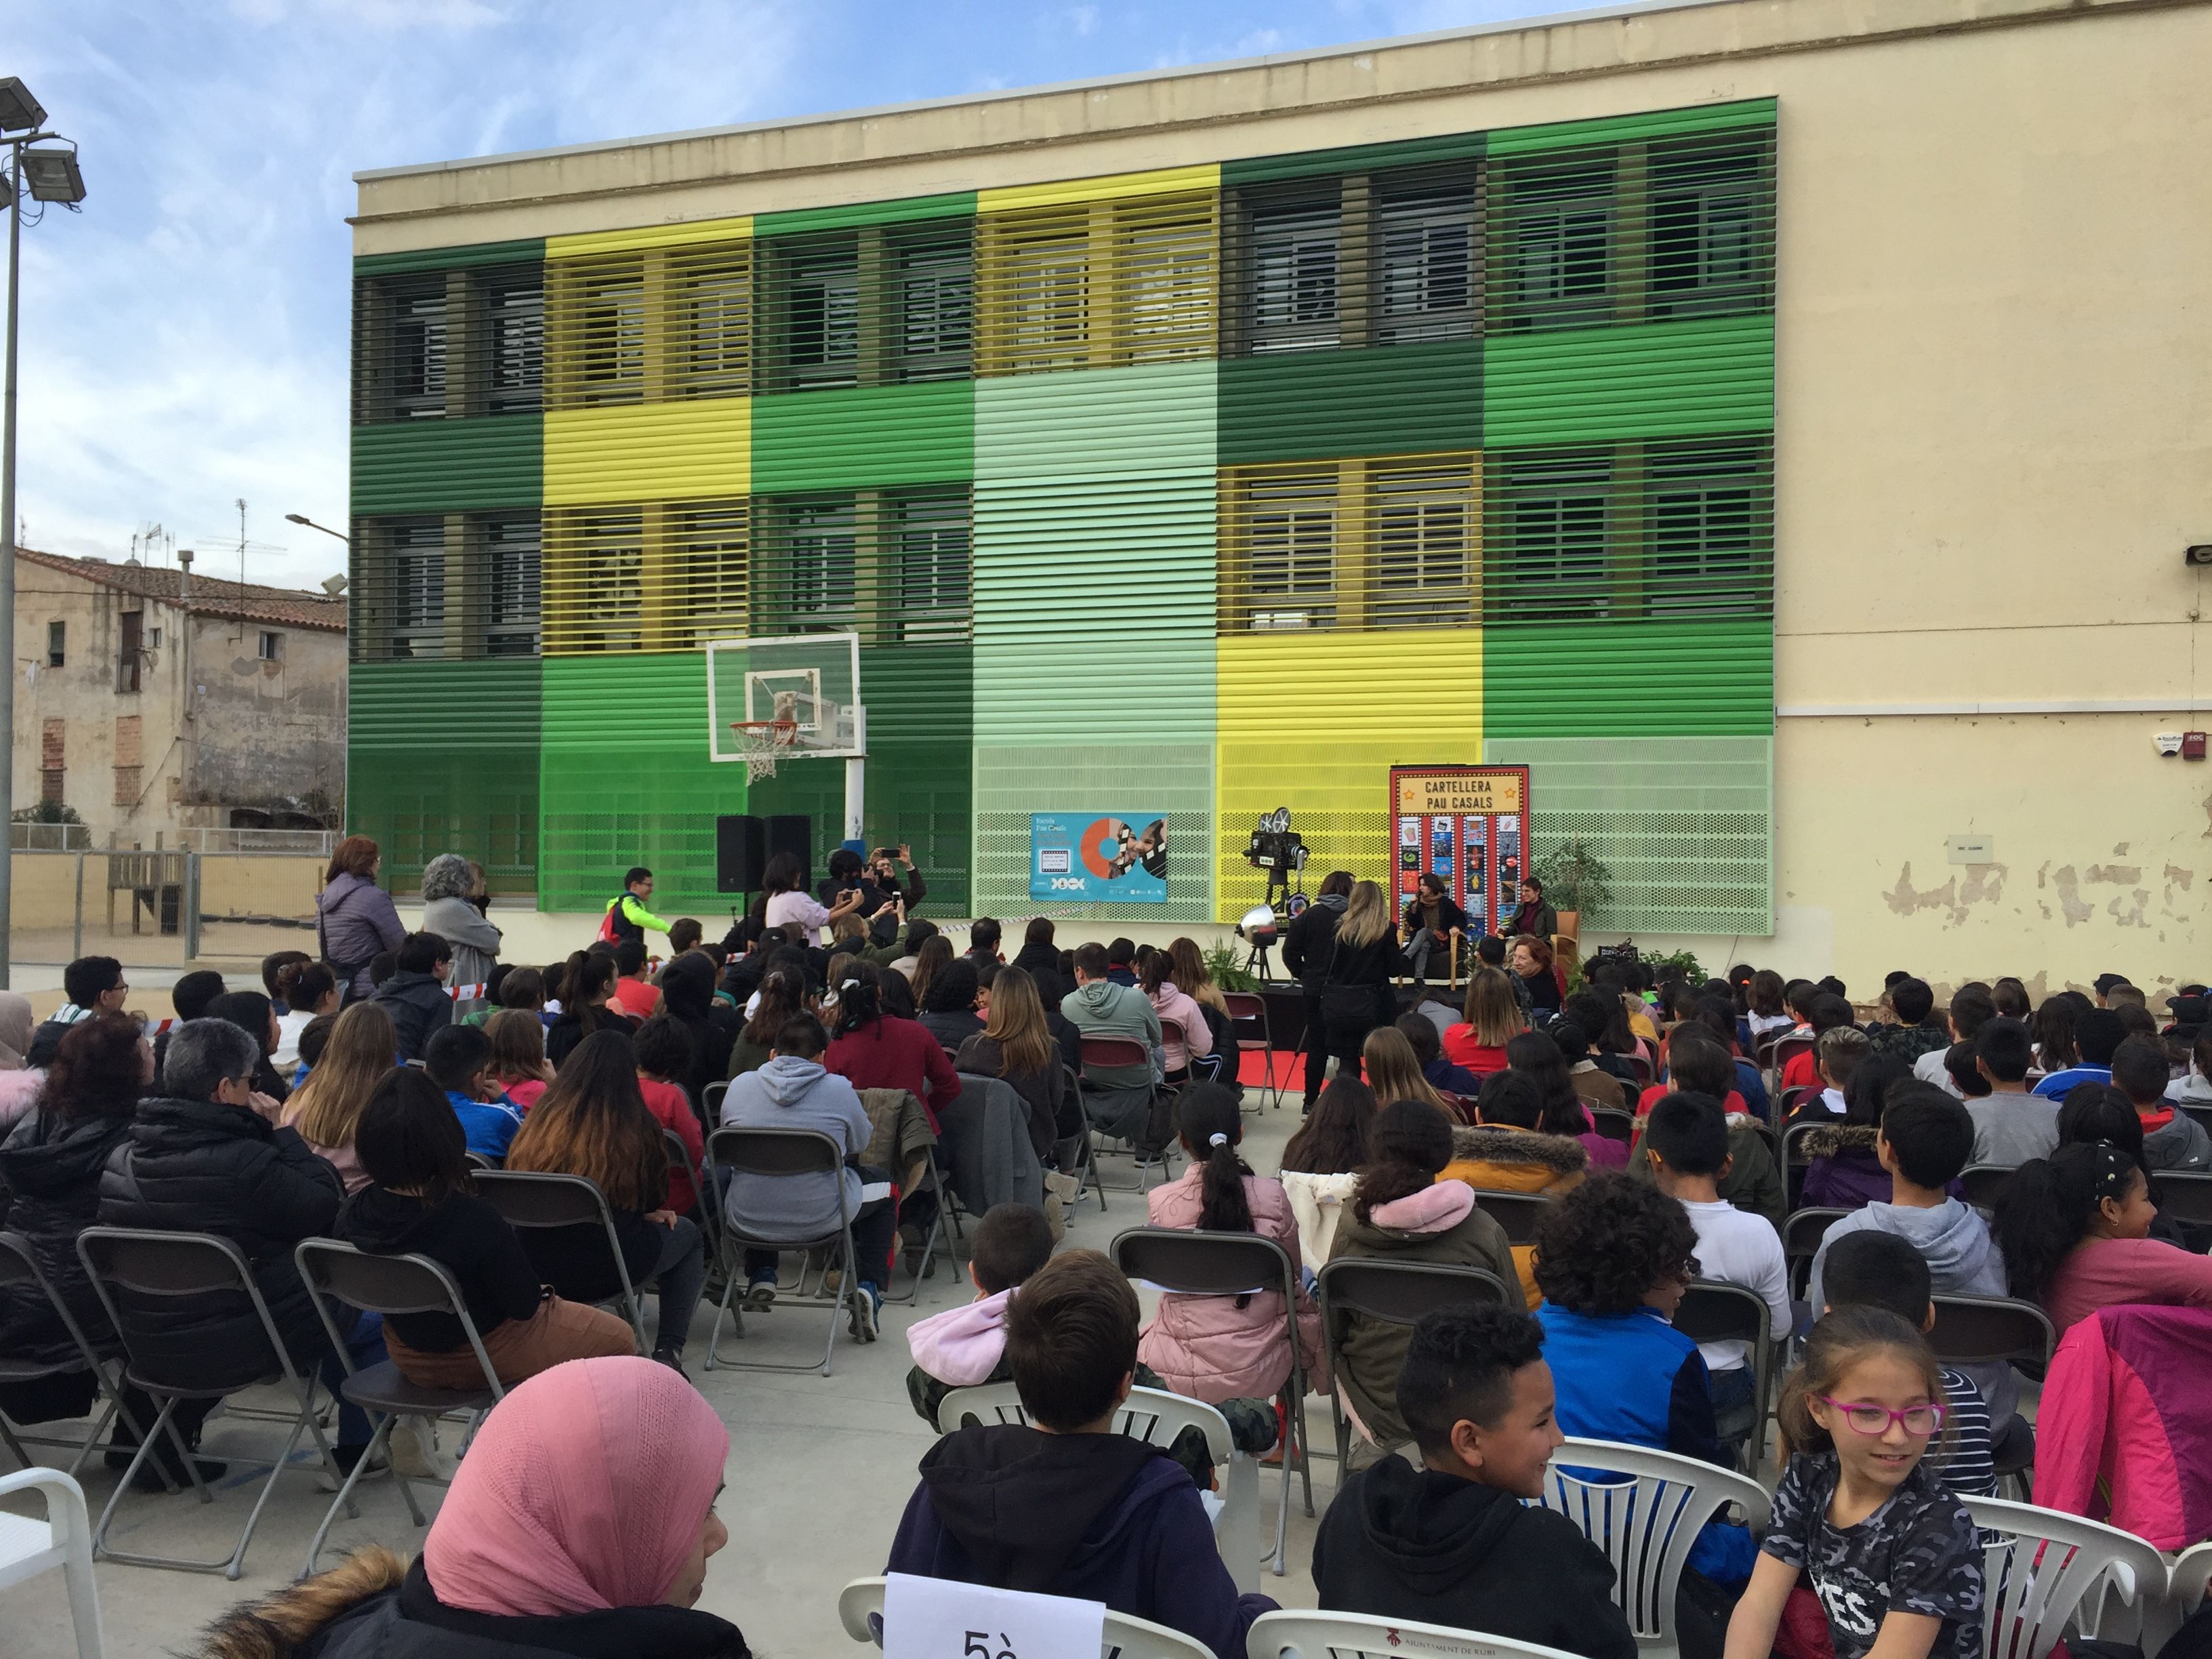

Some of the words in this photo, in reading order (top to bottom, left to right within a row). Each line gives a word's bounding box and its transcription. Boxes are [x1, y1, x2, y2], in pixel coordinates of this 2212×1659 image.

[1425, 781, 1492, 793] CARTELLERA
[1427, 798, 1446, 809] PAU
[1452, 796, 1492, 808] CASALS
[1405, 1639, 1458, 1654] AJUNTAMENT
